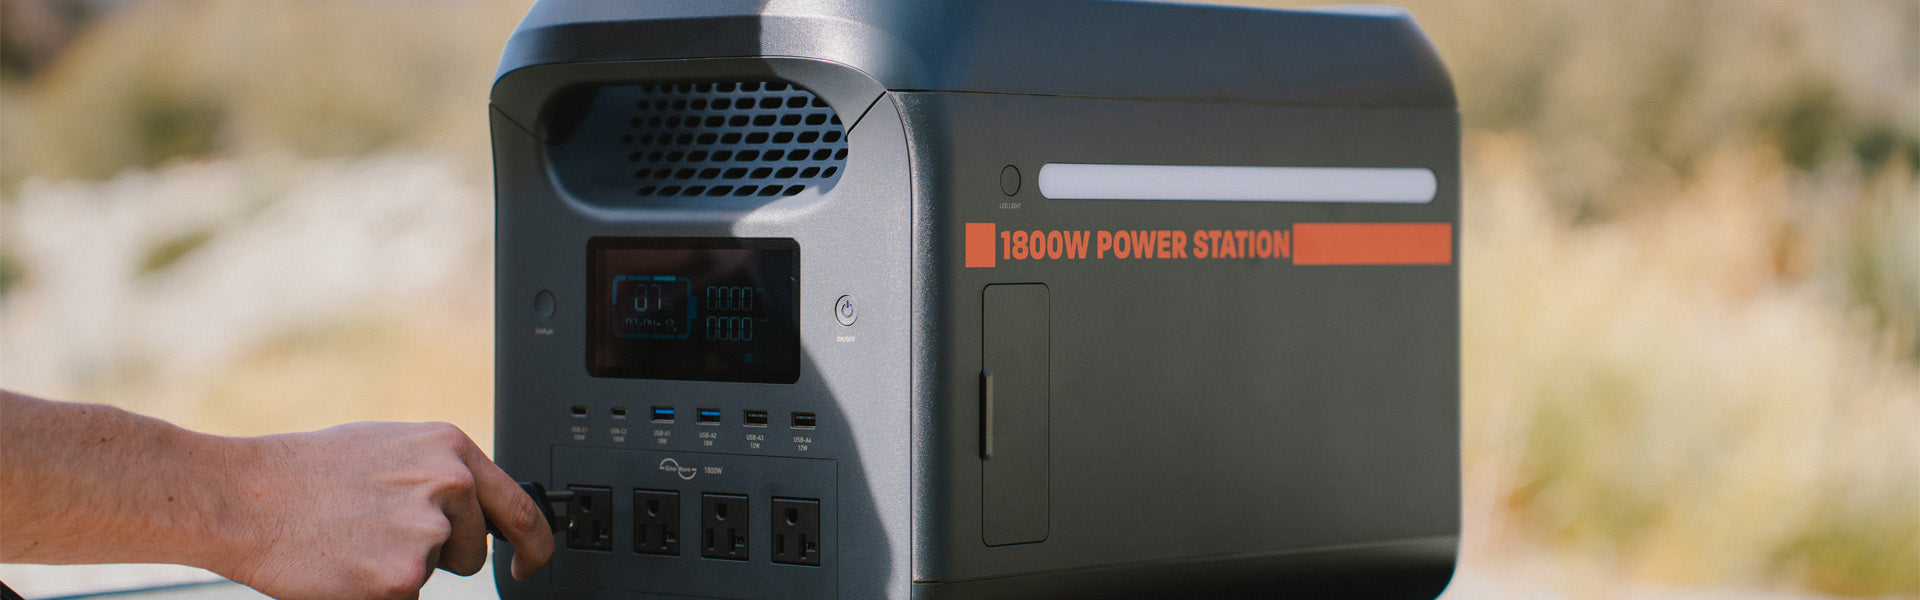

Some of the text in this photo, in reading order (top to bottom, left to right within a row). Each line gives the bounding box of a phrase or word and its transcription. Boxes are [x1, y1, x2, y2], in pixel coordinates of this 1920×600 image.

[1001, 230, 1291, 260] 1800W POWER STATION
[707, 286, 753, 311] 0000
[706, 316, 753, 341] 0000
[704, 466, 723, 475] 1800W
